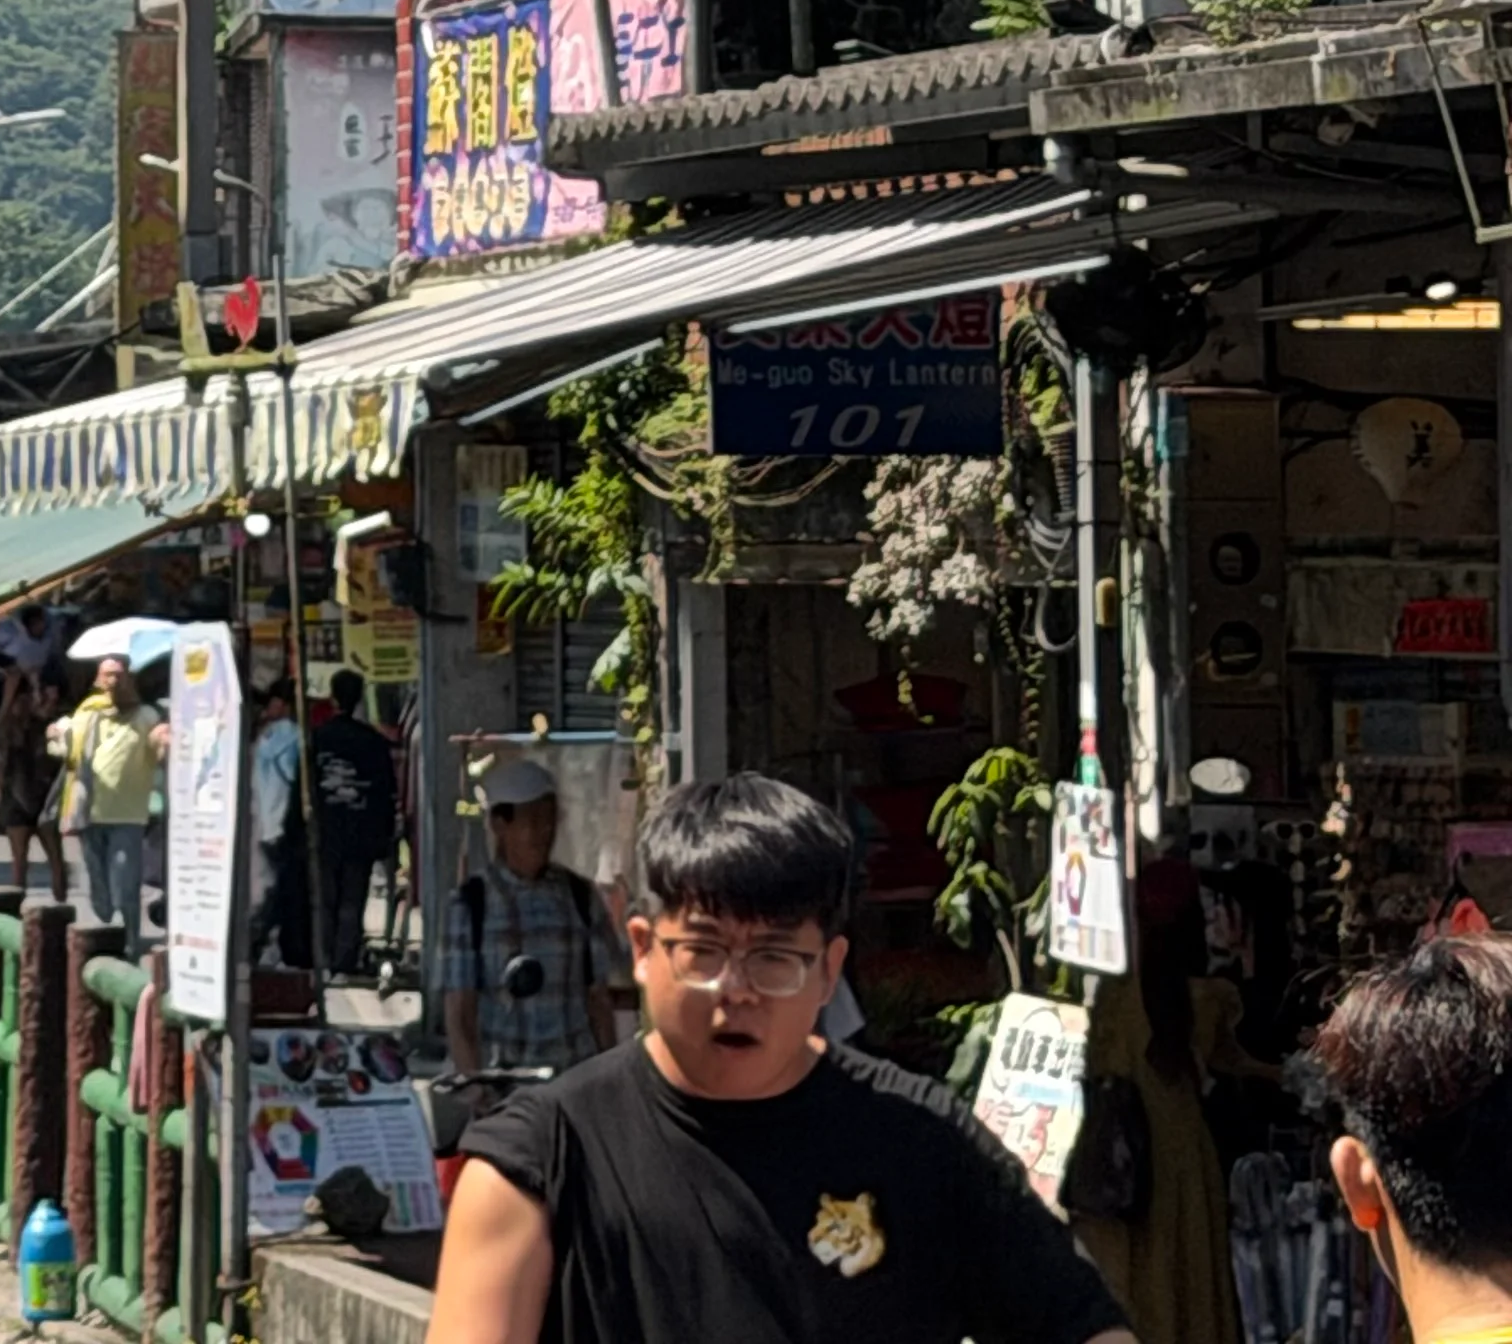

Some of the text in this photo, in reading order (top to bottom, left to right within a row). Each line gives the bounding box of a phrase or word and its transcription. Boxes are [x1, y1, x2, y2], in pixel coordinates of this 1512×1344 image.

[717, 357, 996, 390] Me-guo Sky Lantern
[788, 404, 926, 448] 101
